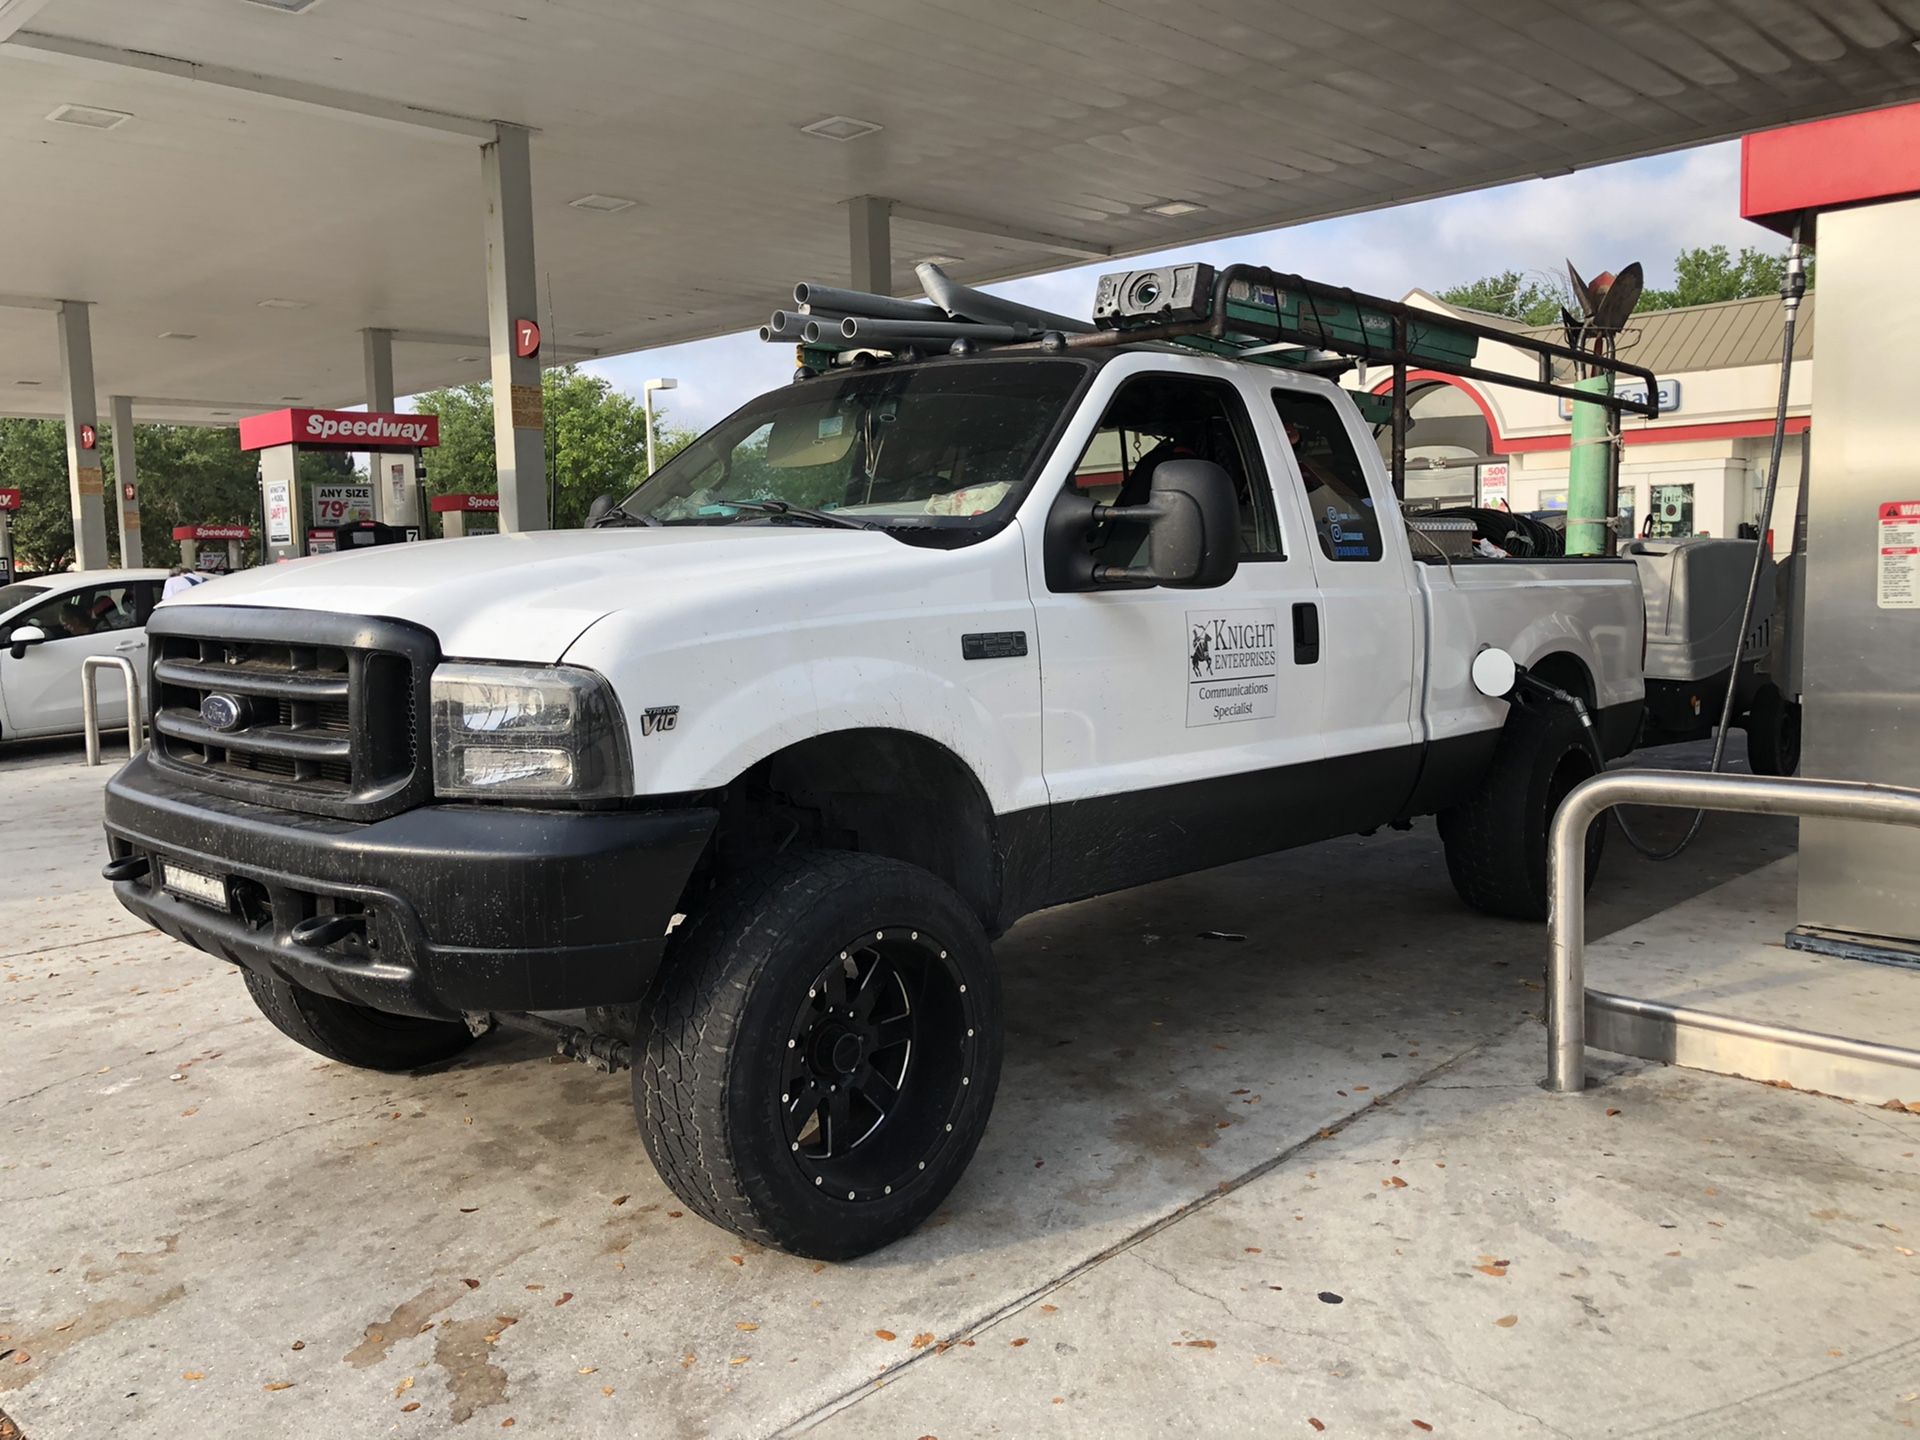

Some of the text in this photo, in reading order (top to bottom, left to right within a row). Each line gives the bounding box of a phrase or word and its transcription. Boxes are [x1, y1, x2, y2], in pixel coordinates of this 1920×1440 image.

[522, 328, 532, 347] 7
[82, 431, 93, 442] 11
[306, 414, 427, 442] Speedway
[1488, 466, 1506, 476] 500
[320, 489, 369, 498] ANY SIZE
[196, 527, 245, 538] Speedway
[408, 531, 417, 542] 7
[1213, 619, 1275, 651] KNIGHT
[1214, 650, 1276, 670] ENTERPRISES
[1199, 683, 1269, 700] Communications
[644, 705, 680, 714] TRITON
[1213, 702, 1253, 720] Specialist
[640, 713, 678, 737] V10
